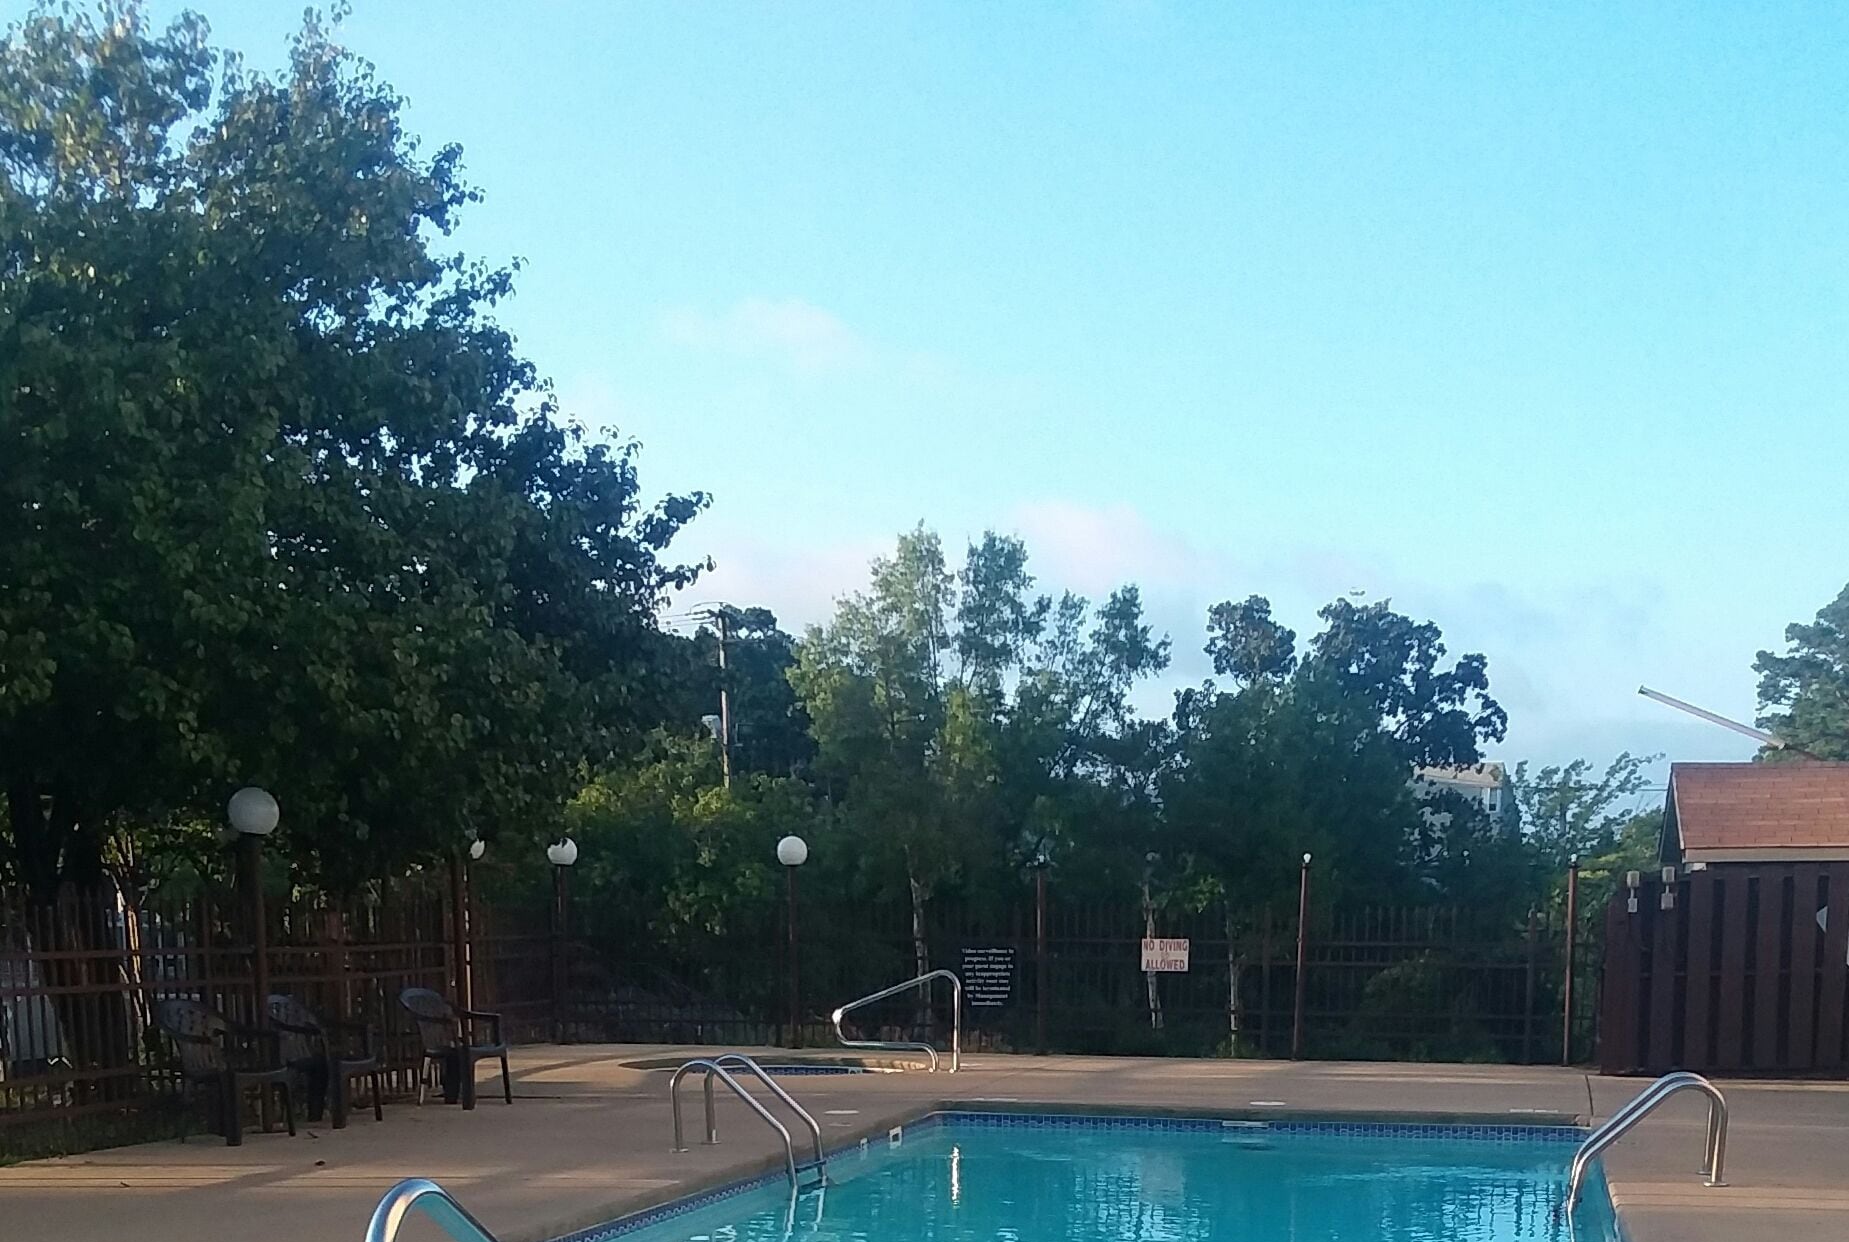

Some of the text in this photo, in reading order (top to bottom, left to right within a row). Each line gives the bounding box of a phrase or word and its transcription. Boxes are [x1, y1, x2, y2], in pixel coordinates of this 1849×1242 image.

[1143, 940, 1188, 952] NO DIVING
[1145, 959, 1185, 970] ALLOWED
